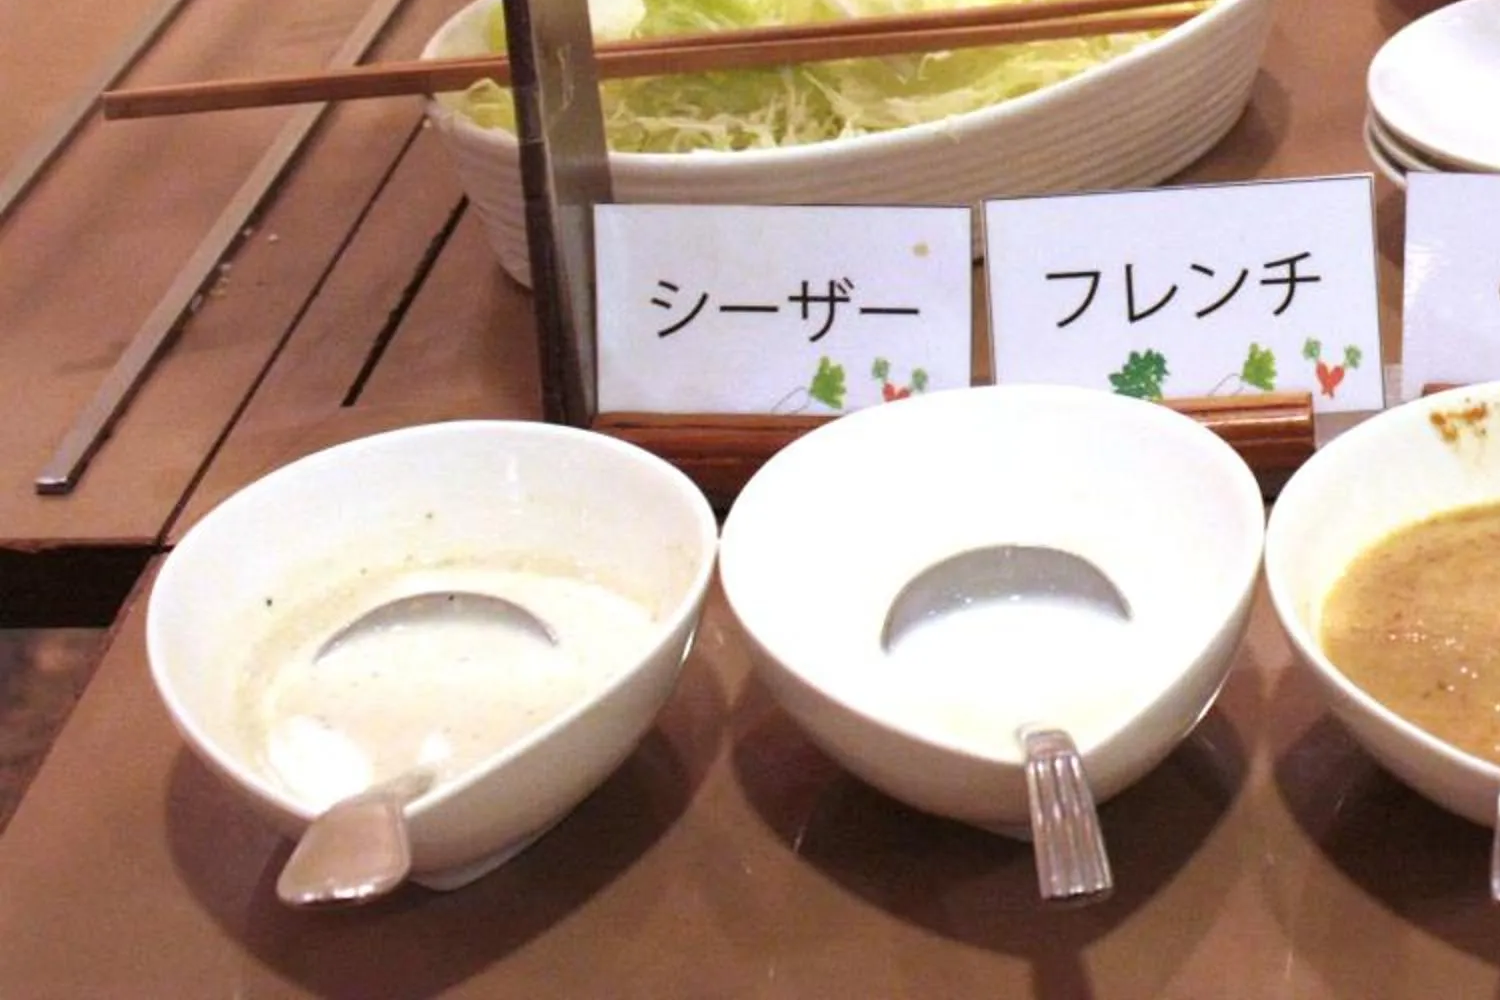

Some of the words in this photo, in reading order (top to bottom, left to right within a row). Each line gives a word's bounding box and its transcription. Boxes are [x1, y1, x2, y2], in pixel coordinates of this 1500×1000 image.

[650, 276, 920, 342] シーザー
[1045, 251, 1321, 328] フレンチ
